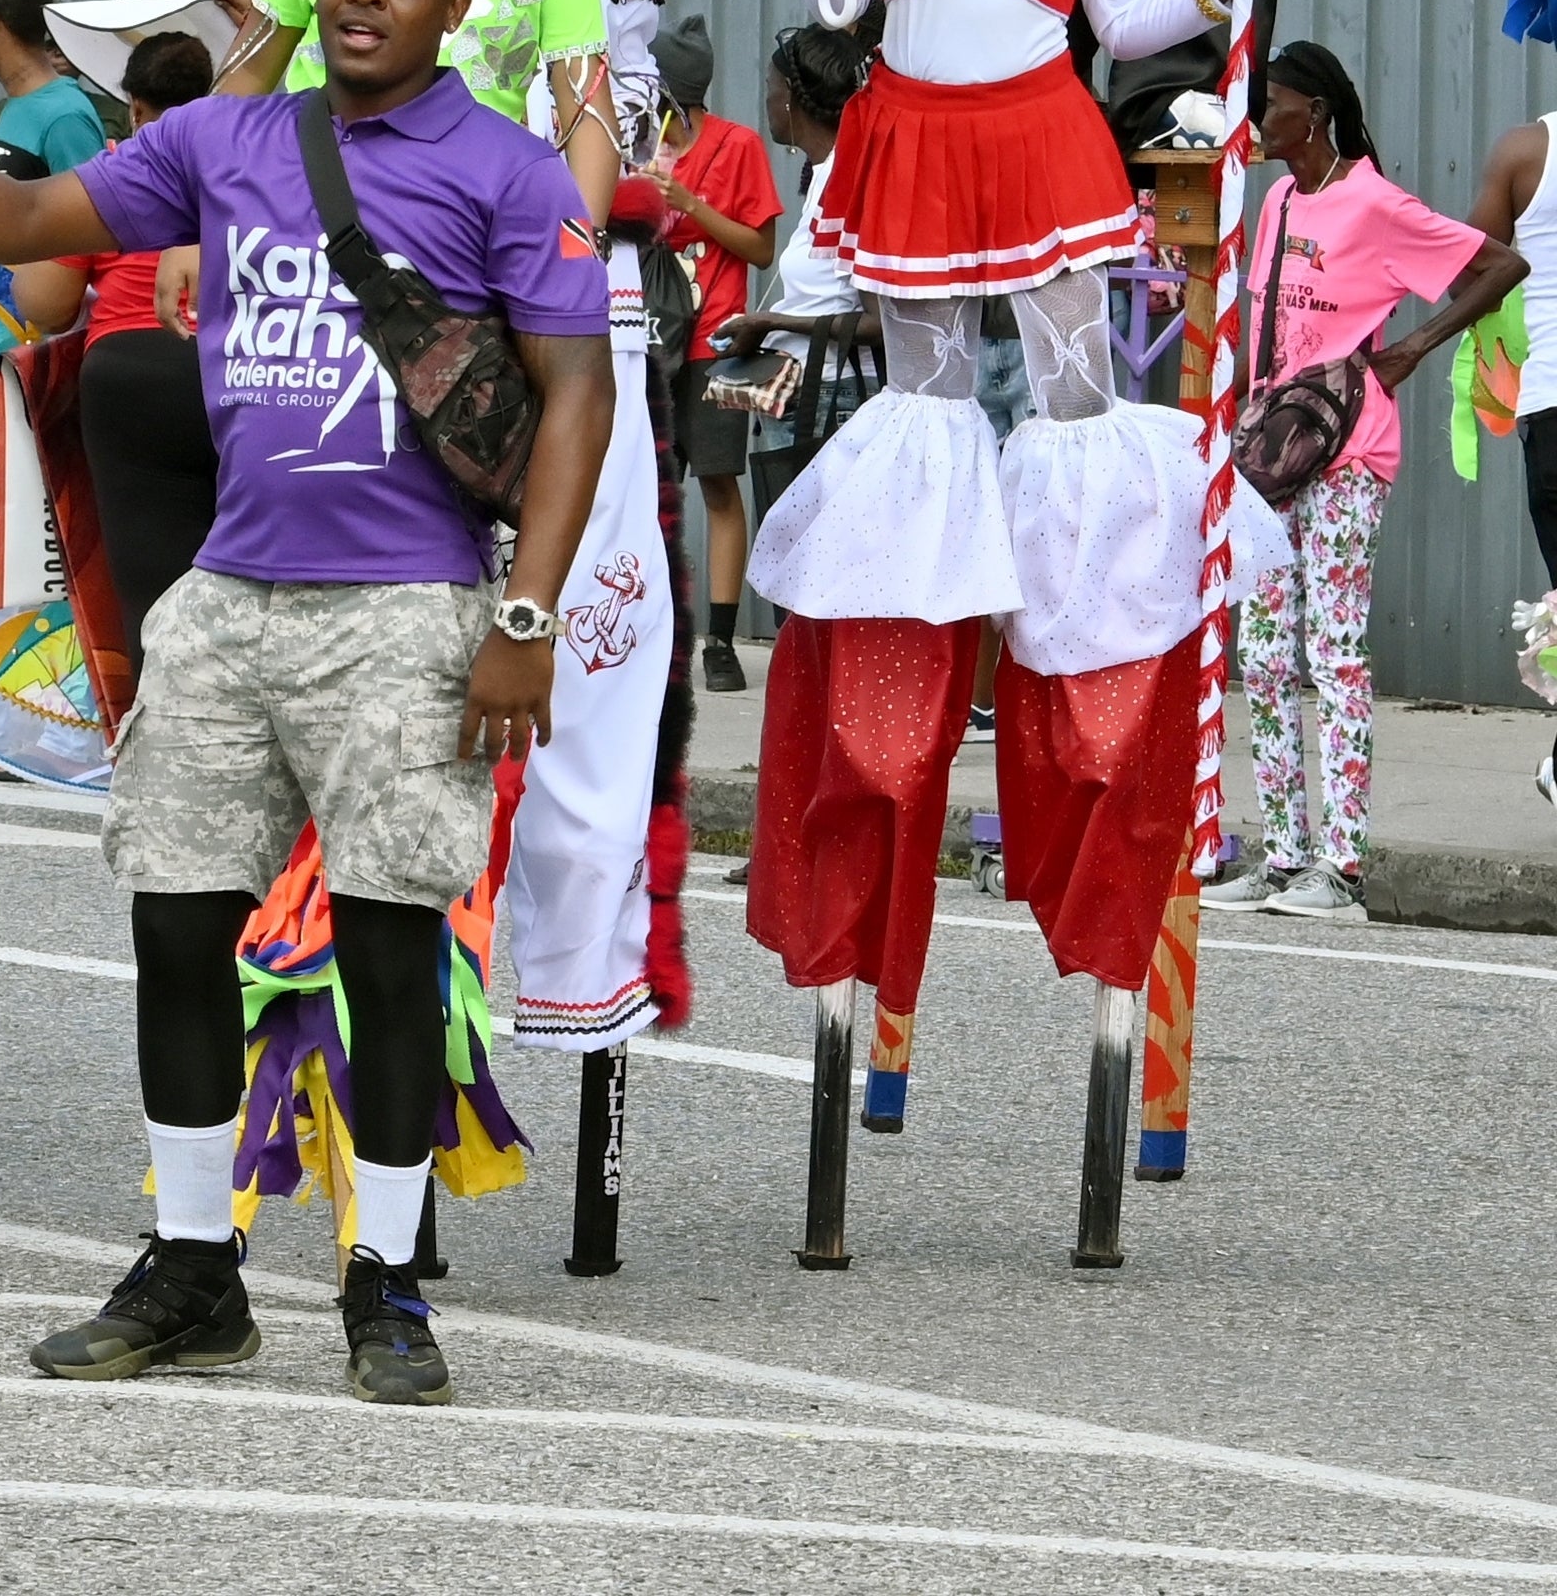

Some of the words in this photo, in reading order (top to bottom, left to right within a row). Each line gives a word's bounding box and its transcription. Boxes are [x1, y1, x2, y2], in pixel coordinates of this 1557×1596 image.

[1297, 284, 1314, 296] TO
[1309, 297, 1339, 313] MEN
[224, 294, 347, 359] Kah
[224, 358, 341, 389] Valencia
[276, 393, 337, 408] GROUP
[603, 1041, 627, 1196] WILLIAMS
